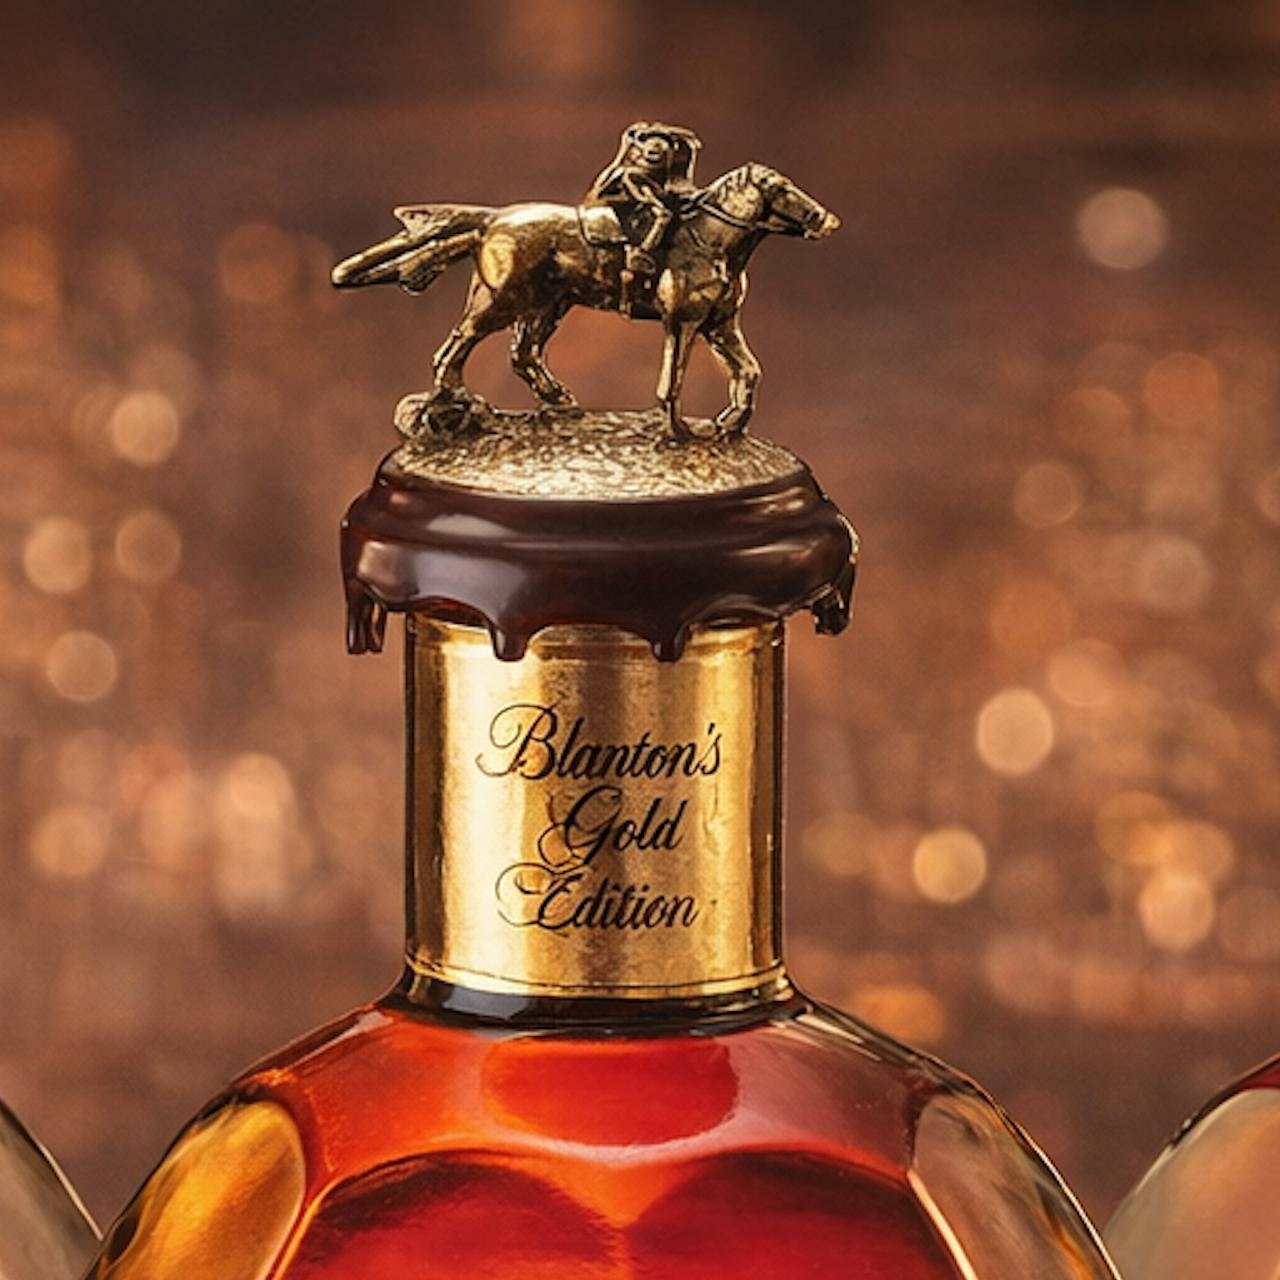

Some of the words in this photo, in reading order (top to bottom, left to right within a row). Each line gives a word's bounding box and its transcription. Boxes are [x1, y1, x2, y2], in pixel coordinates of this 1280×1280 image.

[475, 701, 723, 780] Blanton's
[538, 785, 688, 868] Gold
[495, 862, 699, 938] Edition
